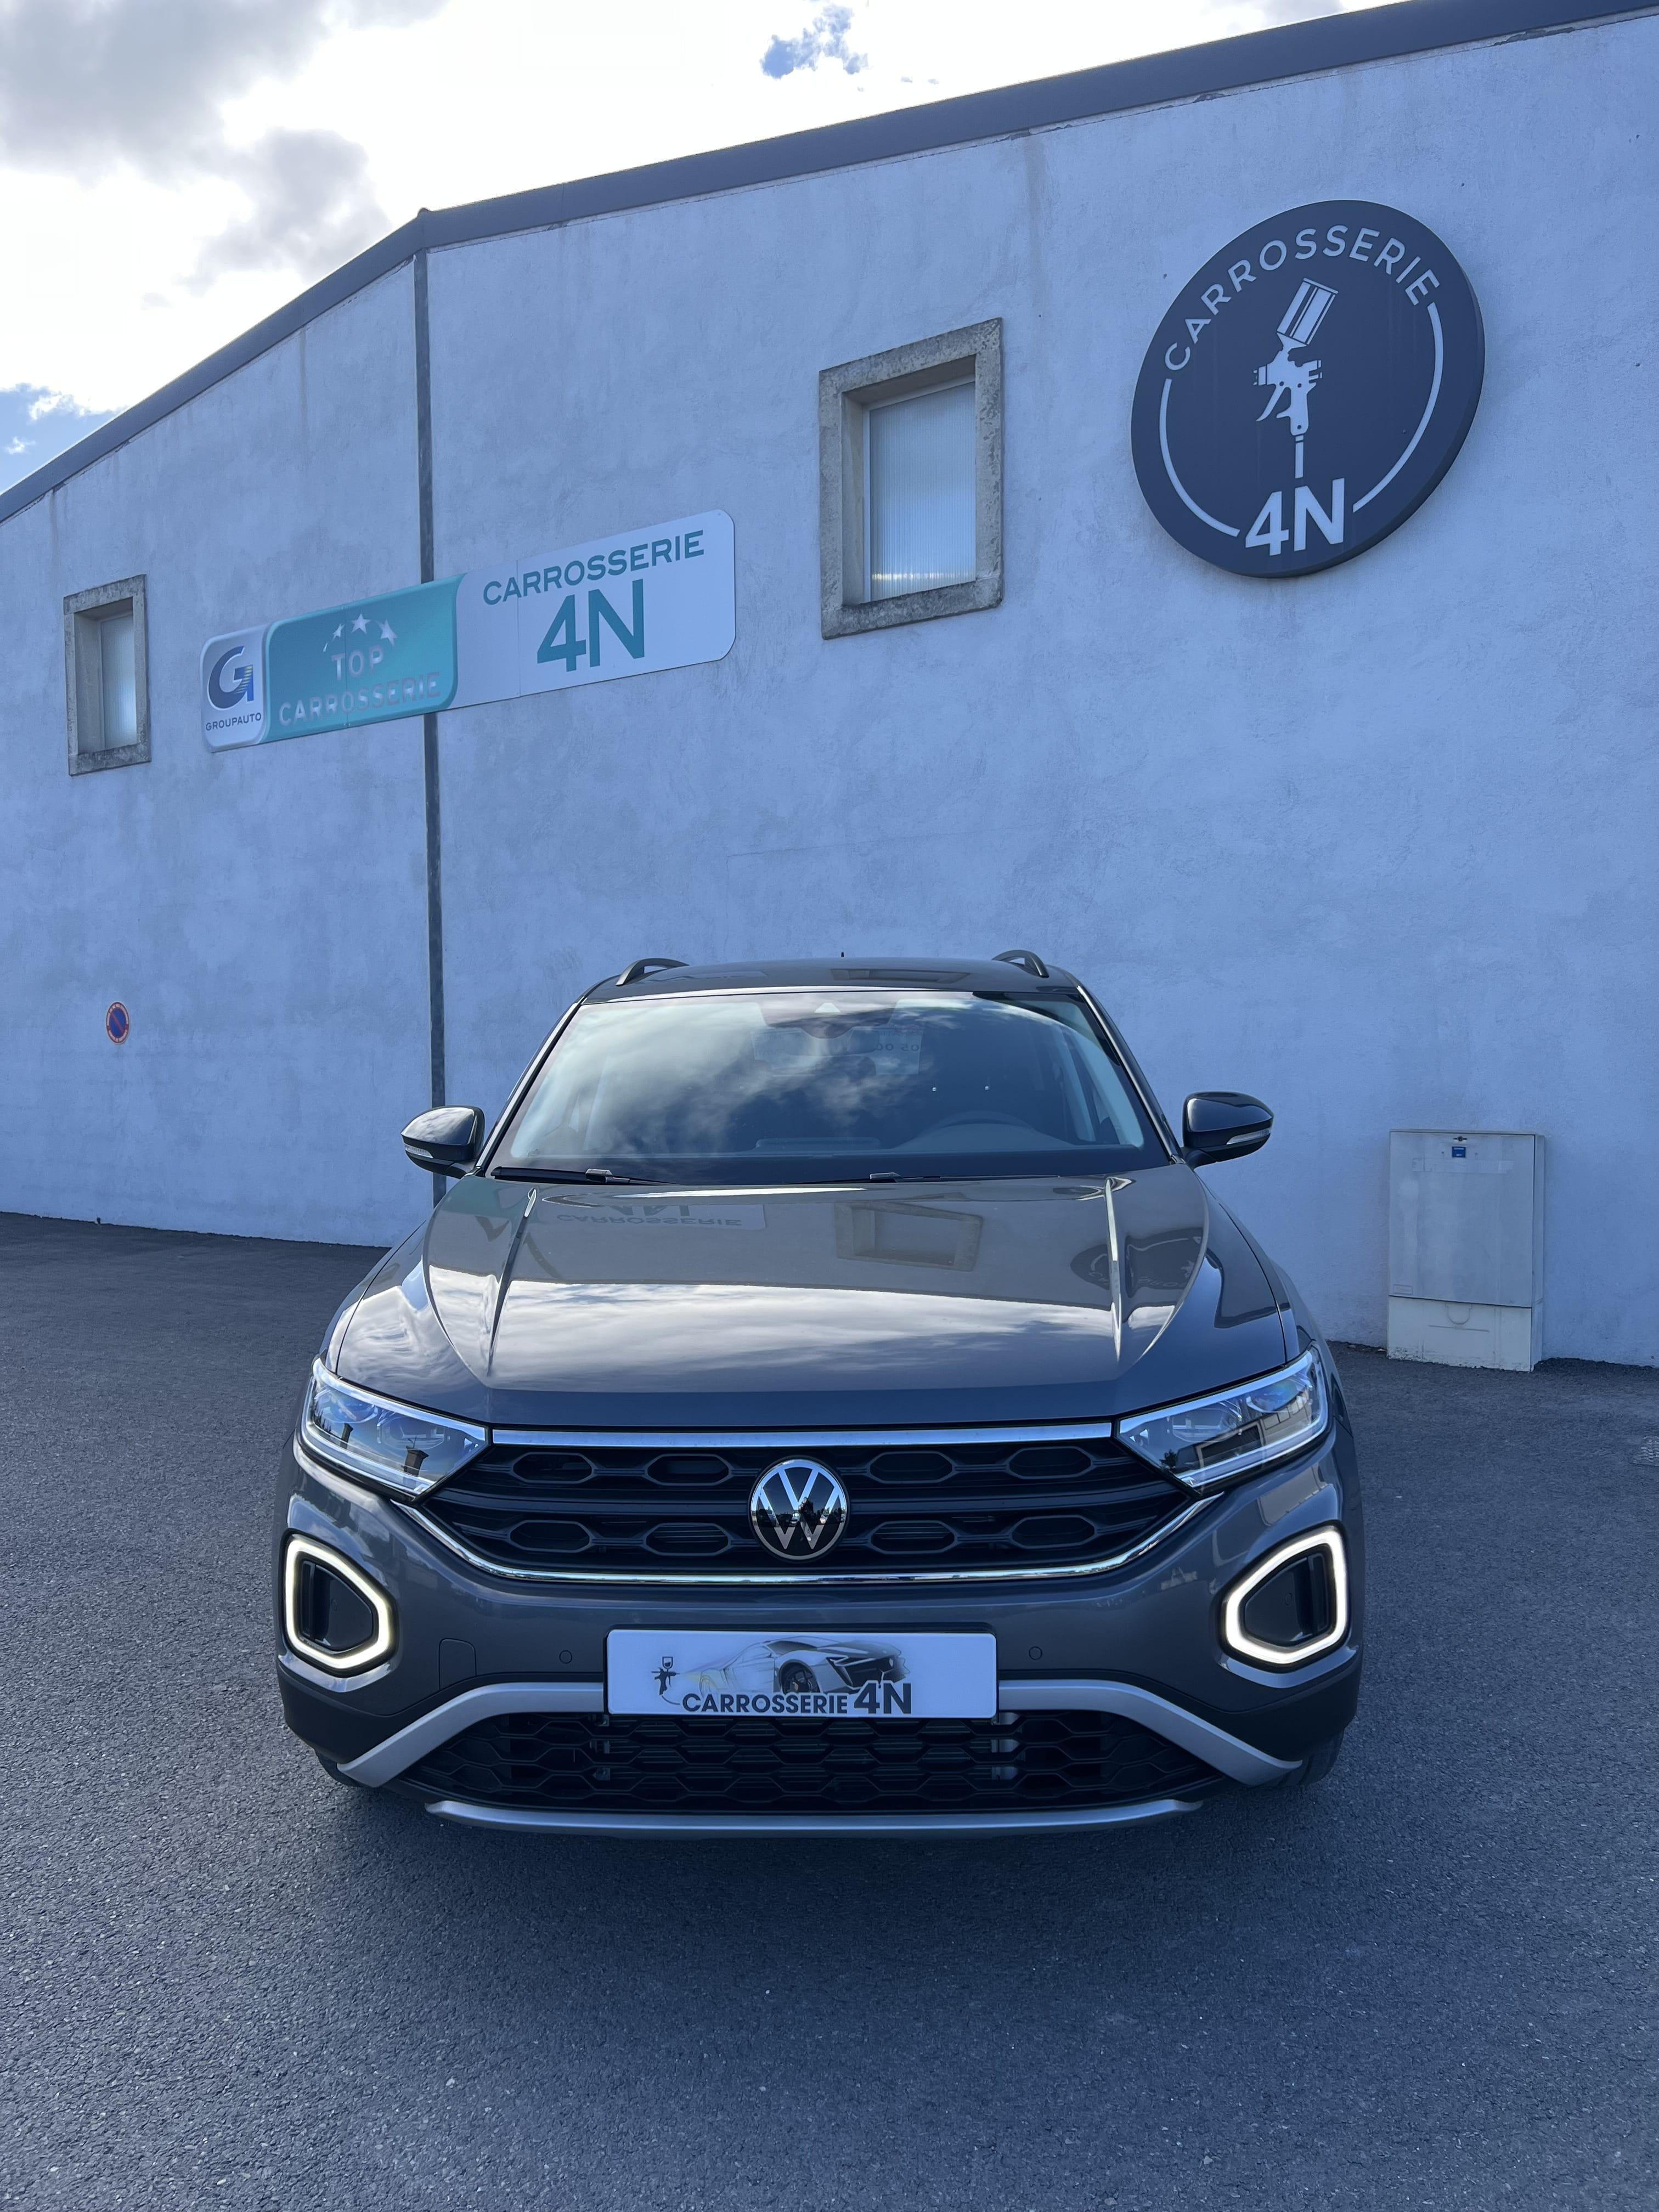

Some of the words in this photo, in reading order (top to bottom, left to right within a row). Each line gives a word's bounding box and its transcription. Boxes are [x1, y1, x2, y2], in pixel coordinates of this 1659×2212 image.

[1164, 224, 1441, 371] CARROSSERIE
[1245, 477, 1345, 556] 4N
[482, 529, 705, 605] CARROSSERIE
[536, 578, 646, 672] 4N
[330, 644, 385, 681] TOP
[205, 713, 262, 731] GROUPAUTO
[279, 672, 441, 727] CARROSSERIE
[682, 1693, 848, 1714] CARROSSERIE
[854, 1682, 912, 1715] 4N
